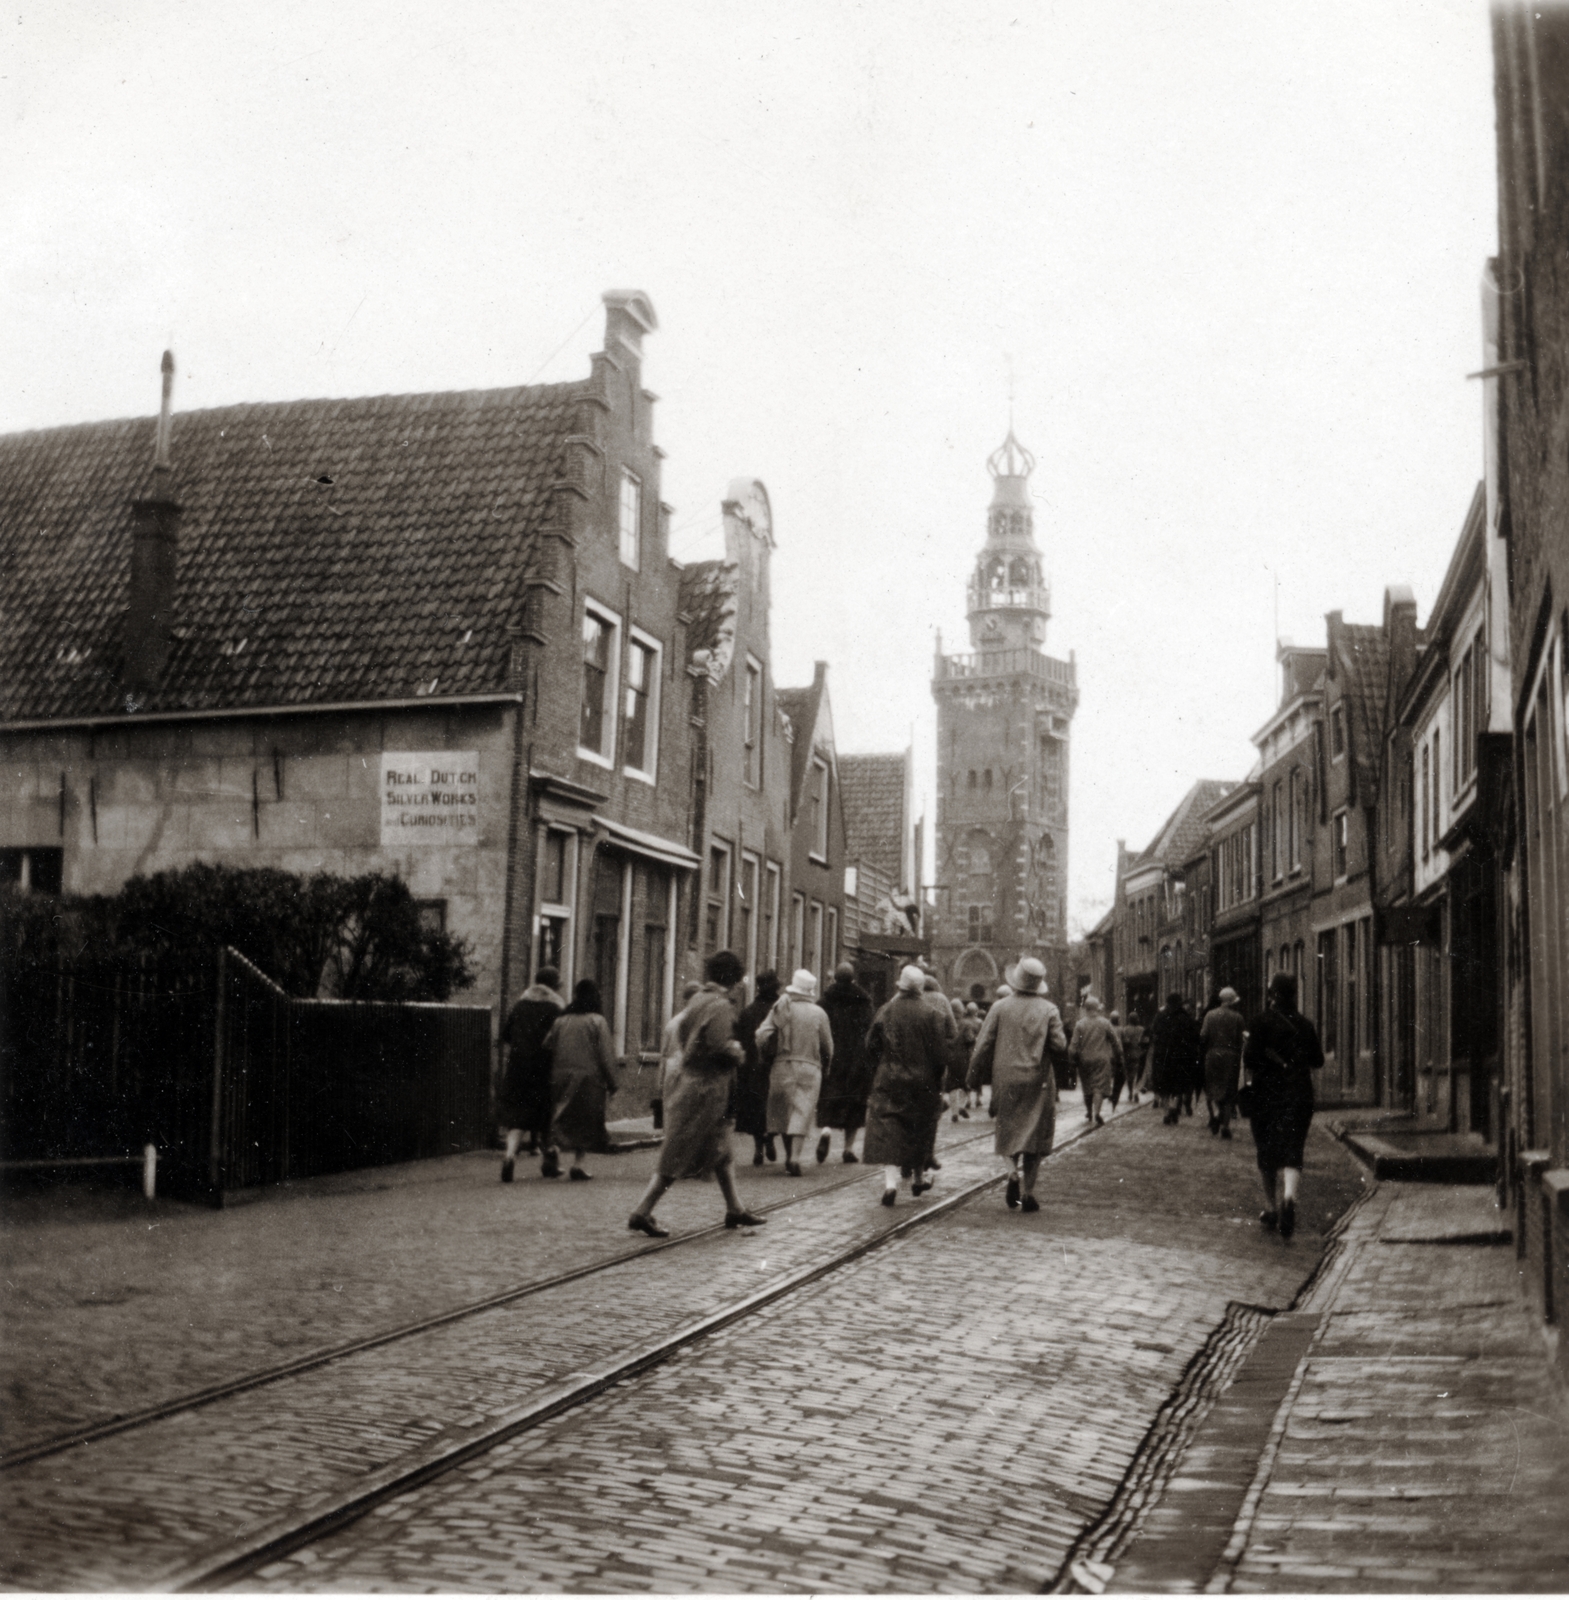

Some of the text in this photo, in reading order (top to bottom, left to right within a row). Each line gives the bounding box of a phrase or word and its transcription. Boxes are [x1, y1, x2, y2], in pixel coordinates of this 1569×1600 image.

[431, 770, 477, 785] DUTCH
[387, 791, 477, 806] SILVER WORKS
[401, 812, 477, 827] CURIOSITIES
